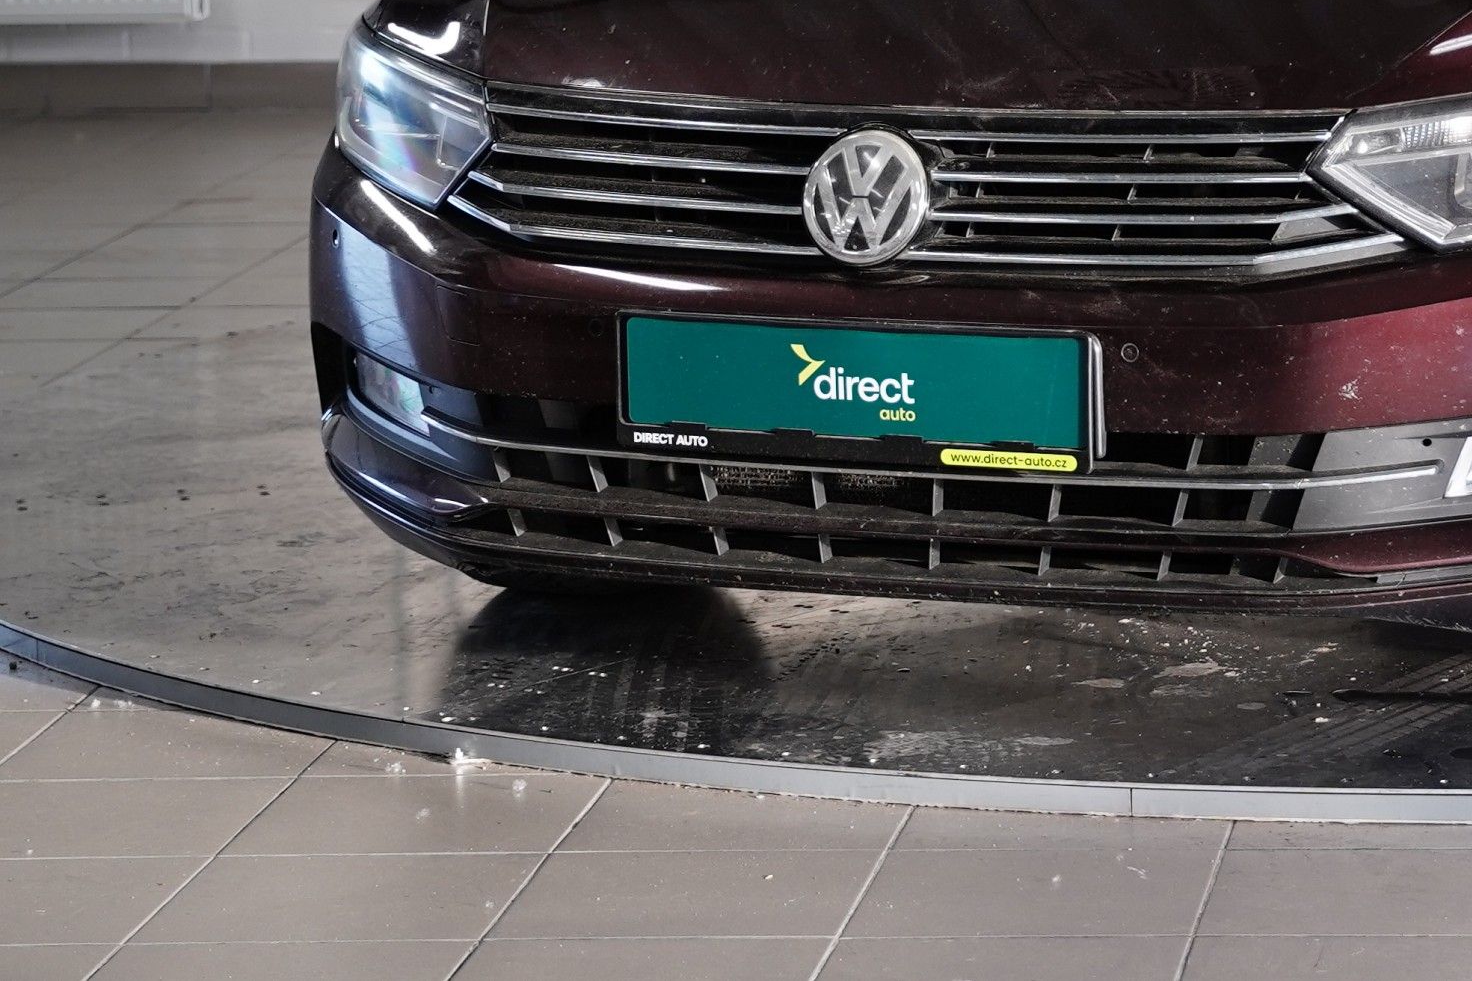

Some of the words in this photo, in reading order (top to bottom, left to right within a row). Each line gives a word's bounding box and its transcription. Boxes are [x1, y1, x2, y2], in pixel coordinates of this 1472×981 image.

[813, 366, 916, 405] direct
[879, 407, 916, 422] auto
[633, 431, 675, 445] DIRECT
[675, 434, 708, 447] AUTO
[950, 453, 1067, 468] www.direct-auto.cz
